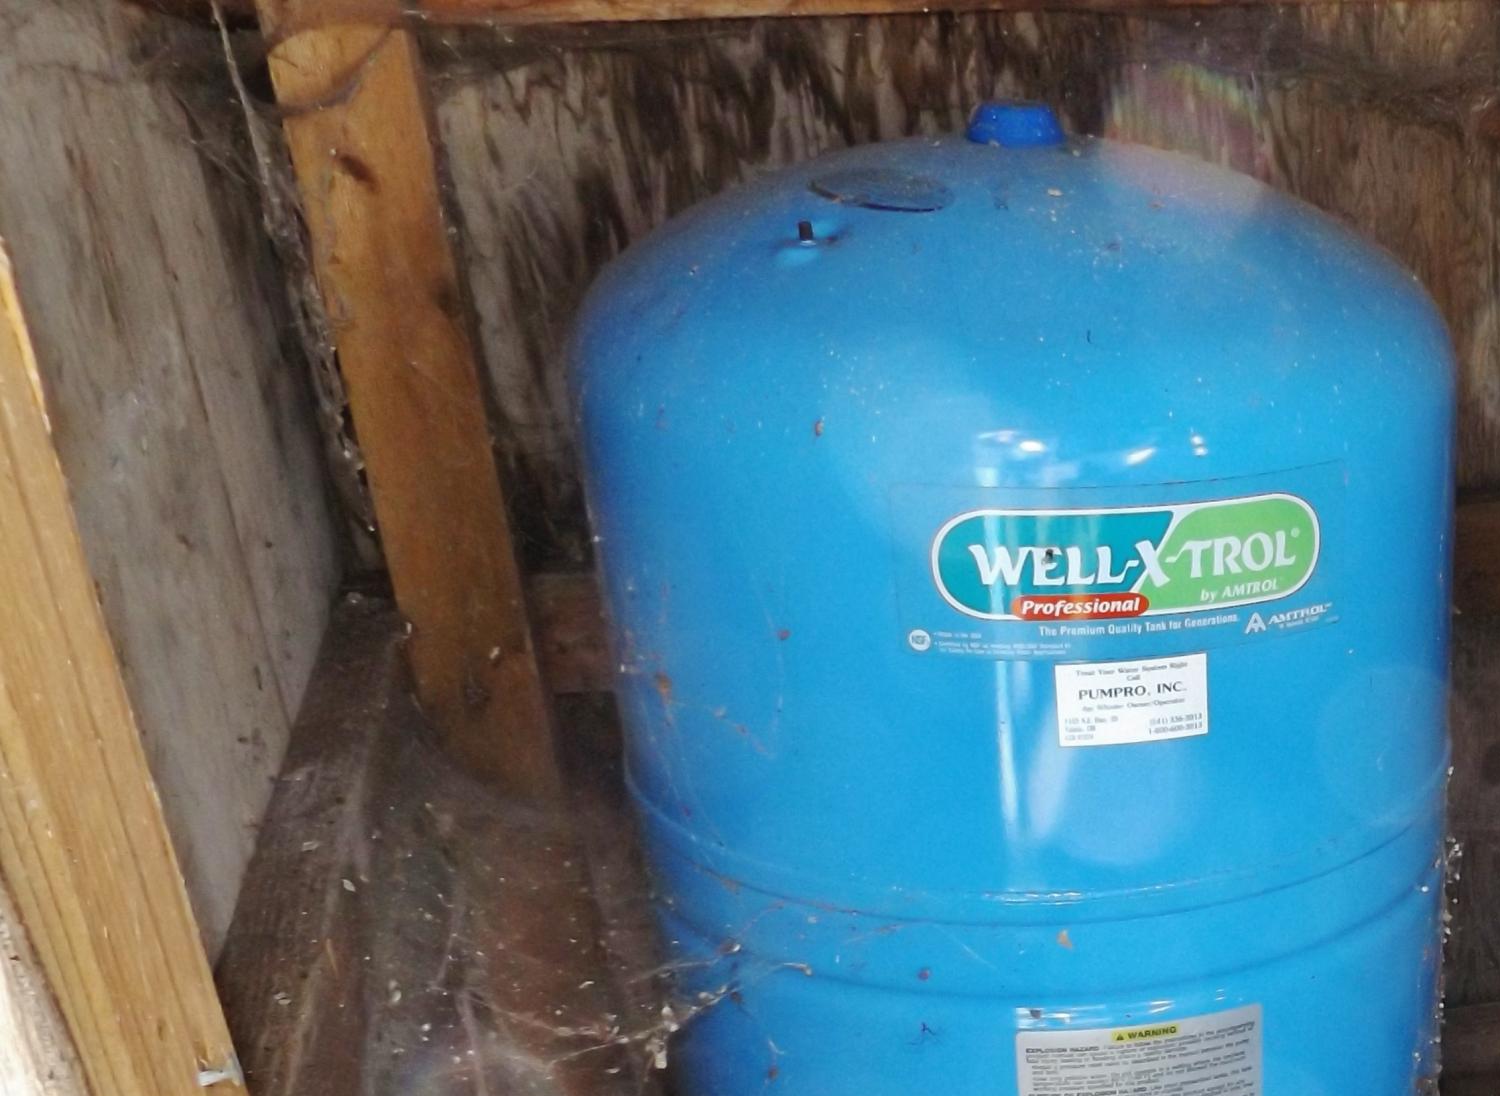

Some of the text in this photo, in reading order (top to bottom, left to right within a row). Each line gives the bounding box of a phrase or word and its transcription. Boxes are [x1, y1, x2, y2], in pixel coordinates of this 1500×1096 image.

[1200, 579, 1278, 603] by AMTROL
[1021, 598, 1140, 616] Professional
[1038, 625, 1057, 637] The
[1060, 624, 1105, 636] Premium
[1108, 622, 1142, 635] Quality
[1146, 620, 1167, 633] Tank
[1169, 619, 1182, 630] for
[1157, 681, 1187, 694] INC.
[1128, 1026, 1177, 1039] WARNING
